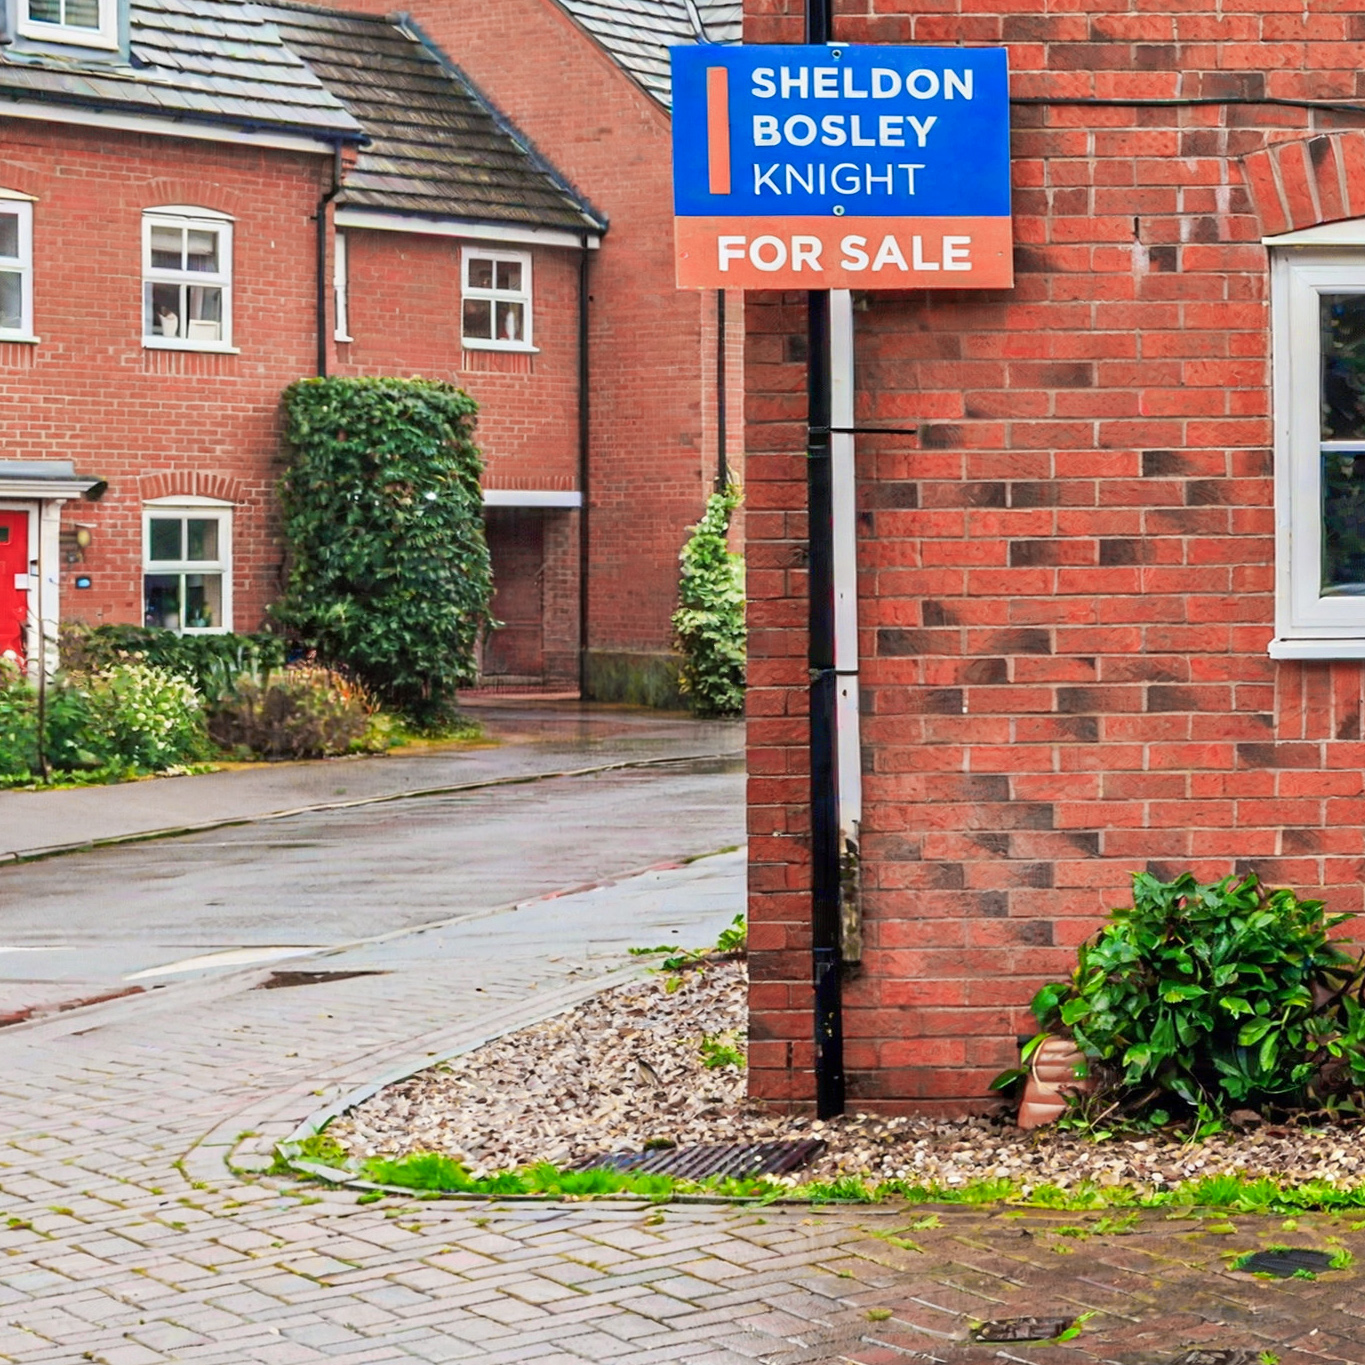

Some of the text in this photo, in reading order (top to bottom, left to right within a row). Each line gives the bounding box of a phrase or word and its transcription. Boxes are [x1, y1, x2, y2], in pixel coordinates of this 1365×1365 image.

[752, 67, 972, 99] SHELDON
[754, 115, 937, 146] BOSLEY
[755, 163, 925, 194] KNIGHT
[718, 235, 971, 271] FOR SALE
